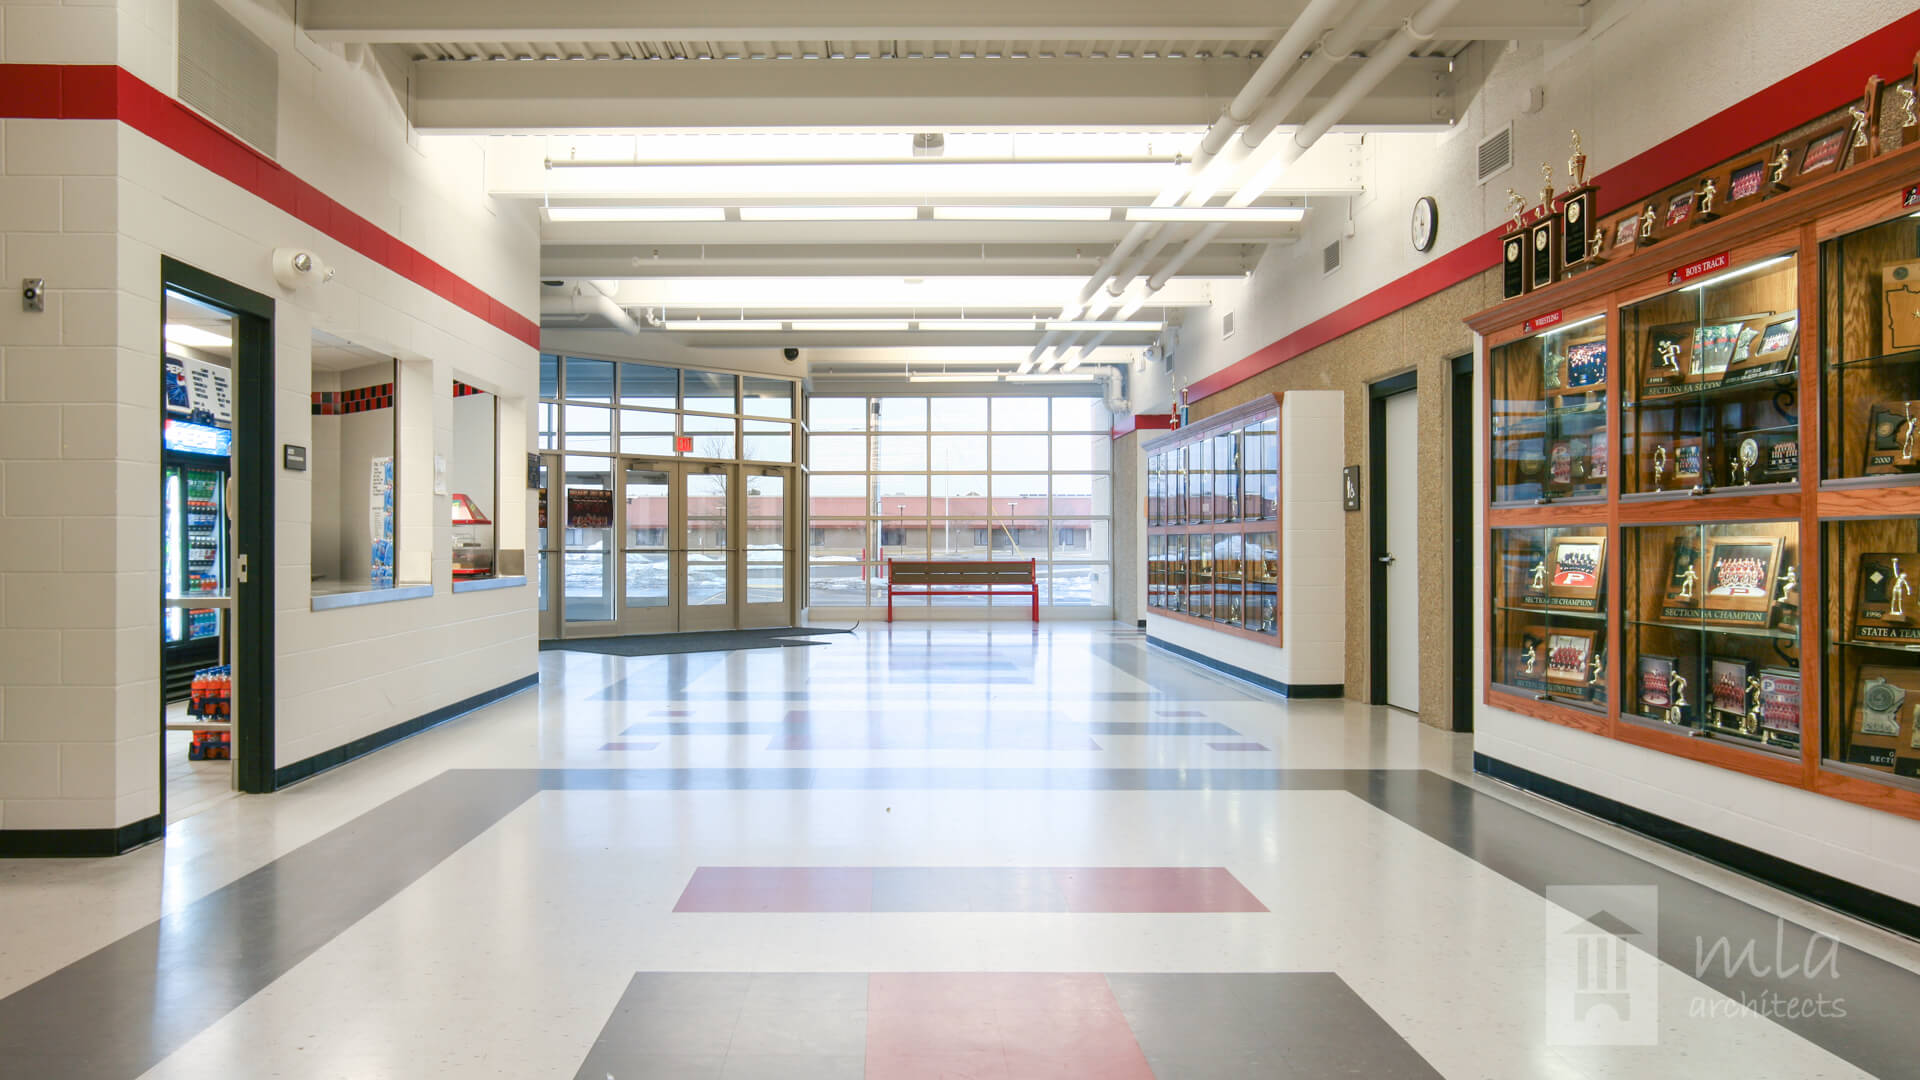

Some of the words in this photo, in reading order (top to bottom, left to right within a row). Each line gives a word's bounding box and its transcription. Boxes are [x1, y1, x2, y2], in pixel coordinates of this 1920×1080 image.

[1685, 263, 1702, 277] BOYS
[1702, 255, 1725, 271] TRACK
[1558, 598, 1593, 608] CHAMPION
[1664, 607, 1700, 617] SECTION
[1713, 609, 1761, 620] CHAMPION
[1861, 627, 1889, 637] STATE
[1890, 628, 1898, 638] A
